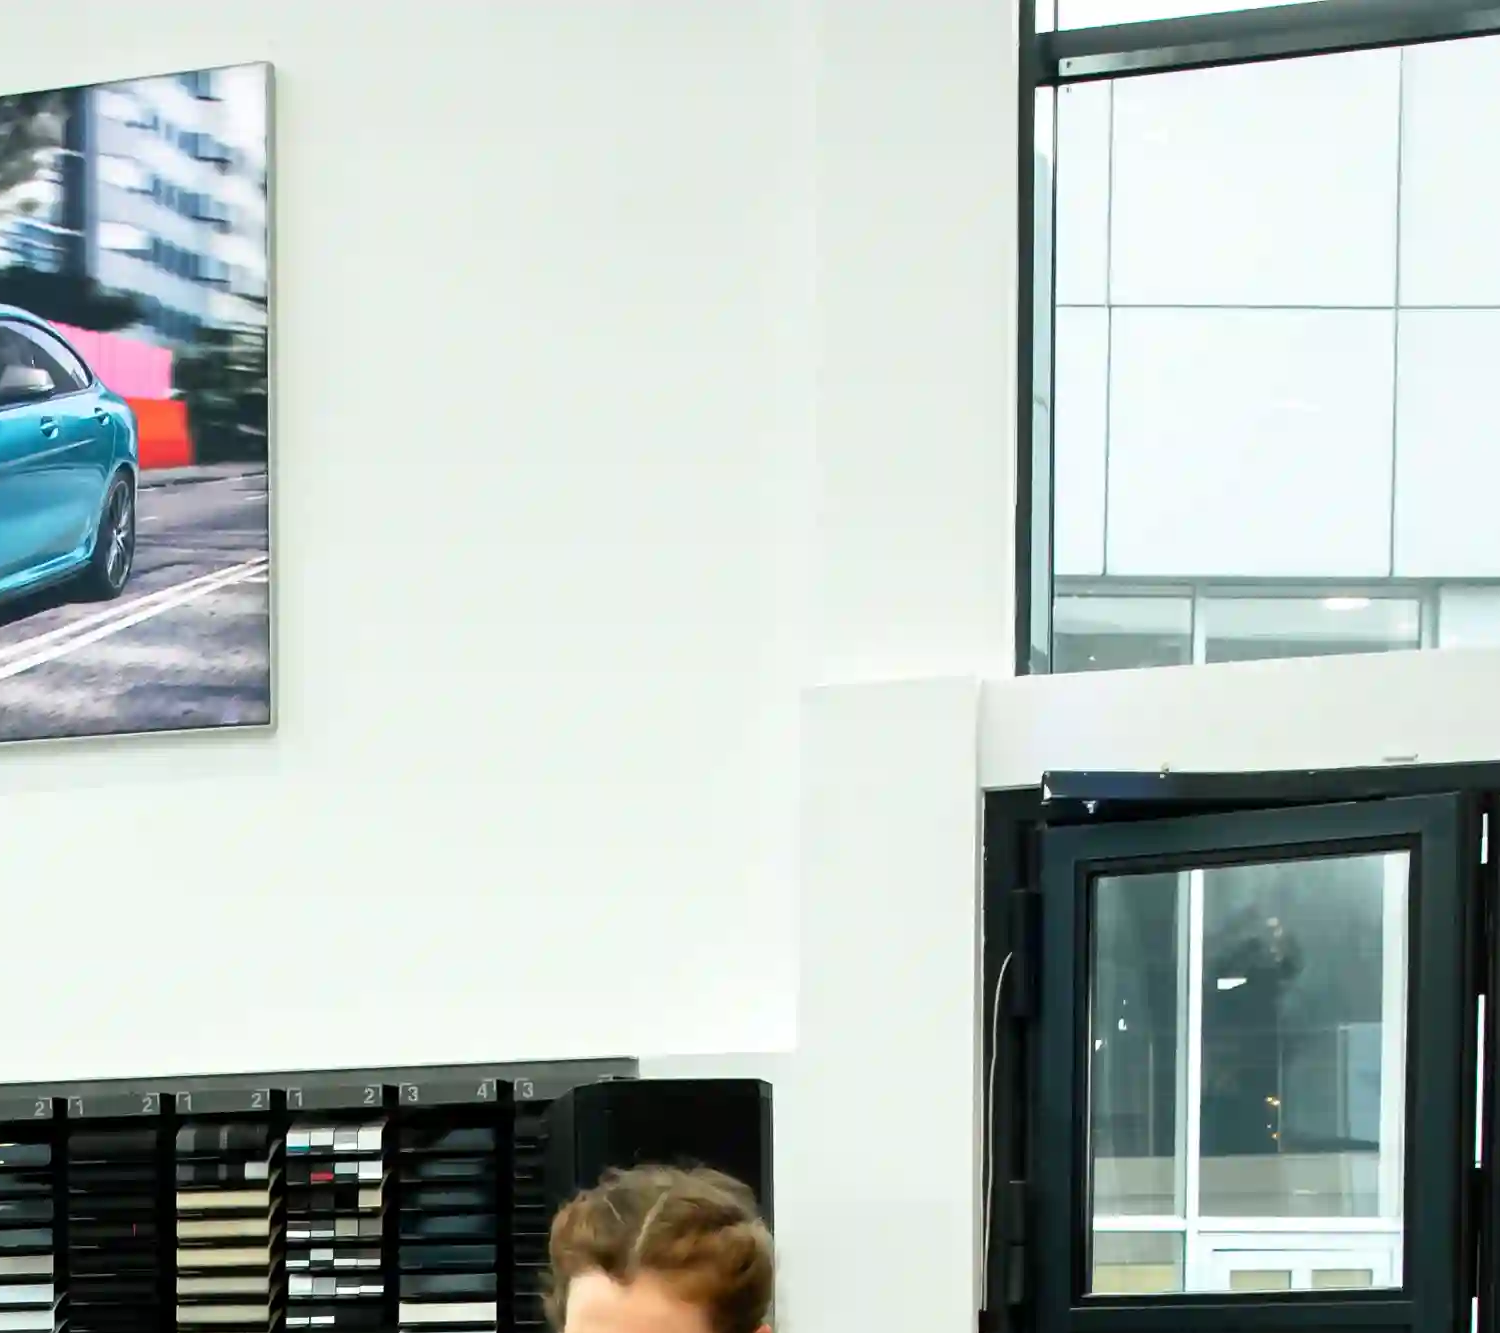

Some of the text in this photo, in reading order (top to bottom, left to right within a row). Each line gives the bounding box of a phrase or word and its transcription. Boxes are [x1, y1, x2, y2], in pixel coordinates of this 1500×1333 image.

[363, 1088, 375, 1104] 2
[407, 1082, 488, 1102] 3 4
[522, 1082, 534, 1098] 3
[142, 1097, 153, 1112] 2
[251, 1093, 263, 1108] 2
[34, 1101, 45, 1116] 2
